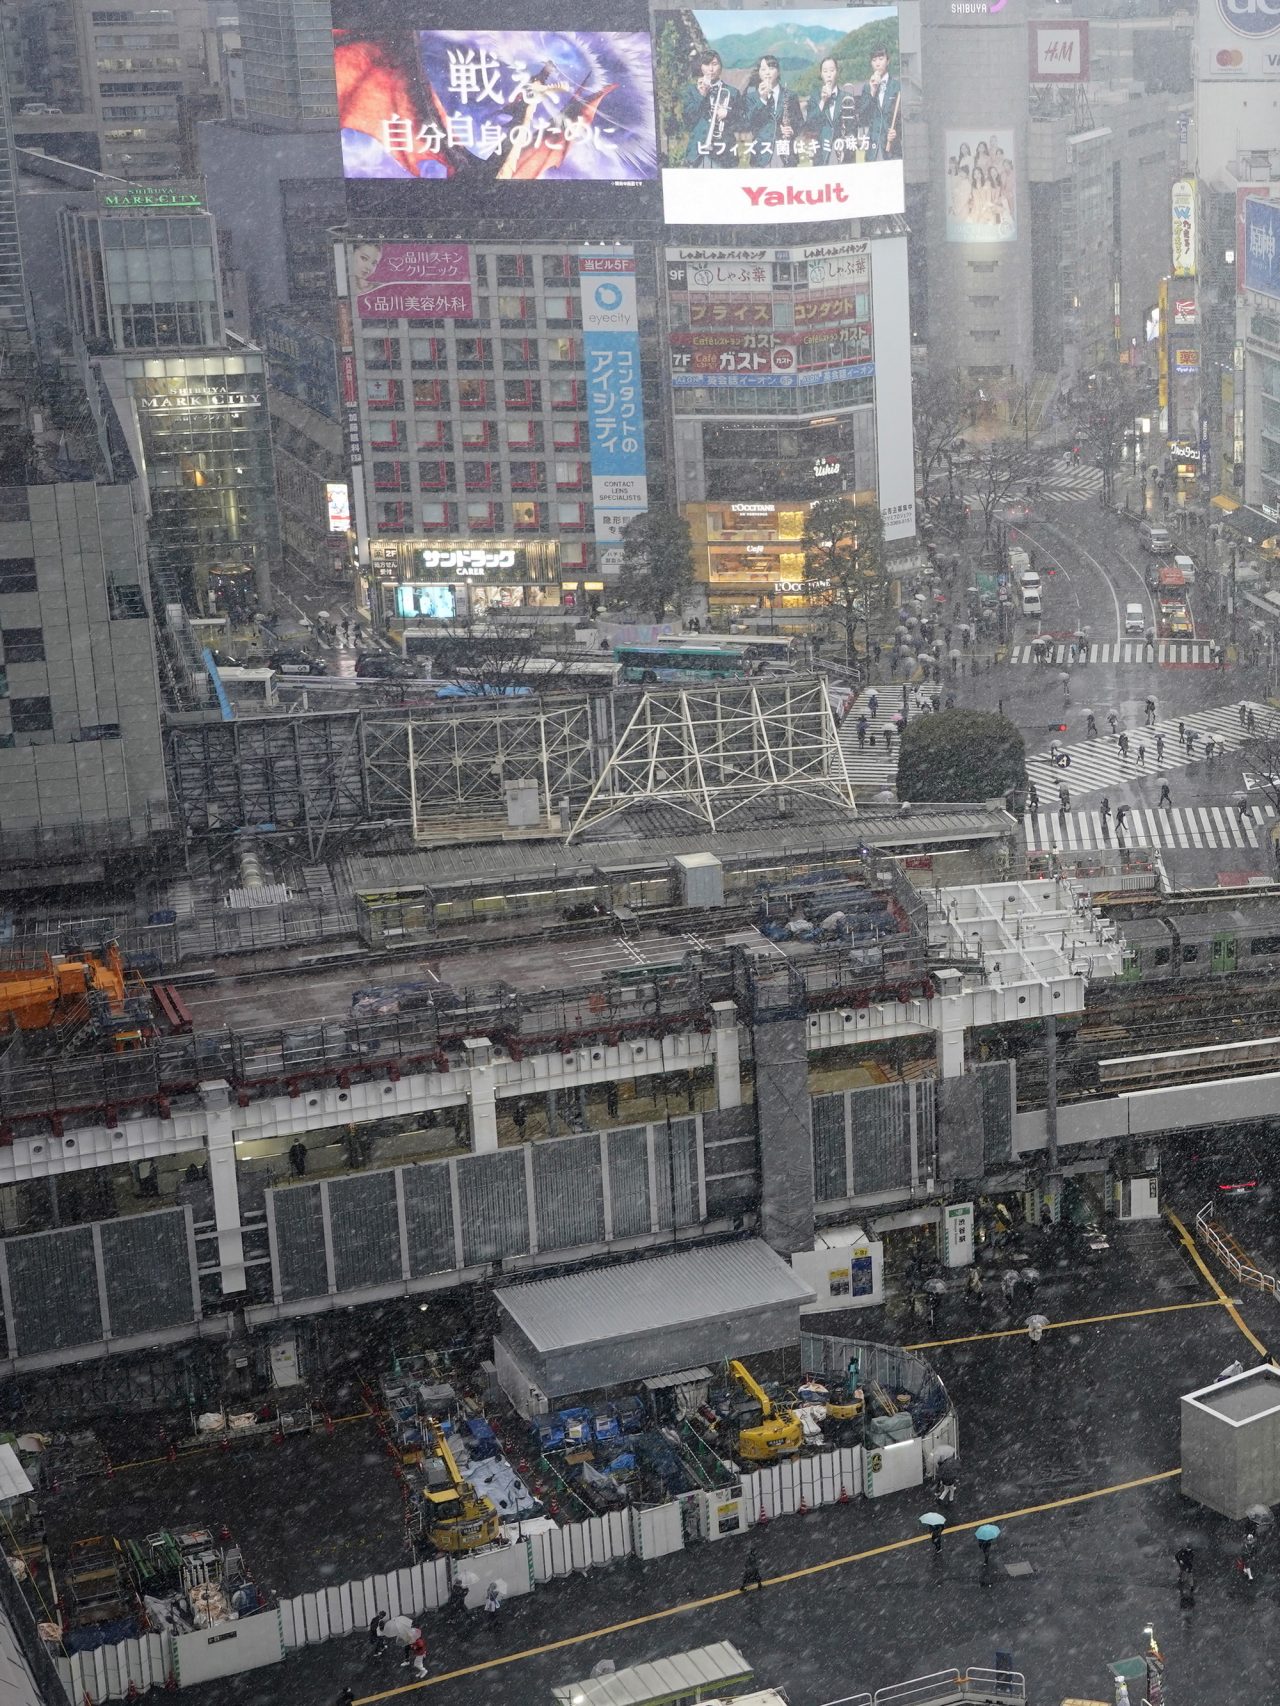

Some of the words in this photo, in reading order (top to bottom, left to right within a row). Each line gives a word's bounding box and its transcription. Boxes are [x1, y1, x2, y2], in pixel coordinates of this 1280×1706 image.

[951, 3, 987, 13] SHIBUYA
[382, 111, 619, 157] 自分自身のために
[697, 136, 880, 156] ビフィズス菌はキミの味方。
[106, 196, 152, 204] MARK
[158, 194, 198, 203] CITY
[742, 182, 849, 207] Yakult
[405, 252, 463, 264] 品川スキン
[584, 258, 629, 271] 当ビル5F
[406, 265, 458, 276] クリニック
[669, 269, 685, 281] 9F
[716, 266, 767, 283] しゃぶ葉
[374, 297, 466, 312] 品川美容外科
[588, 312, 631, 325] eyecity
[743, 334, 781, 348] ガスト
[839, 326, 867, 342] ガスト
[673, 353, 692, 366] 7F
[719, 352, 767, 371] ガスト
[142, 397, 201, 408] MARK
[211, 395, 260, 405] CITY
[590, 351, 616, 454] アイシティ
[616, 351, 639, 454] コンタクトの
[731, 504, 776, 512] L'OCCITANE
[423, 550, 516, 568] サンドラッグ
